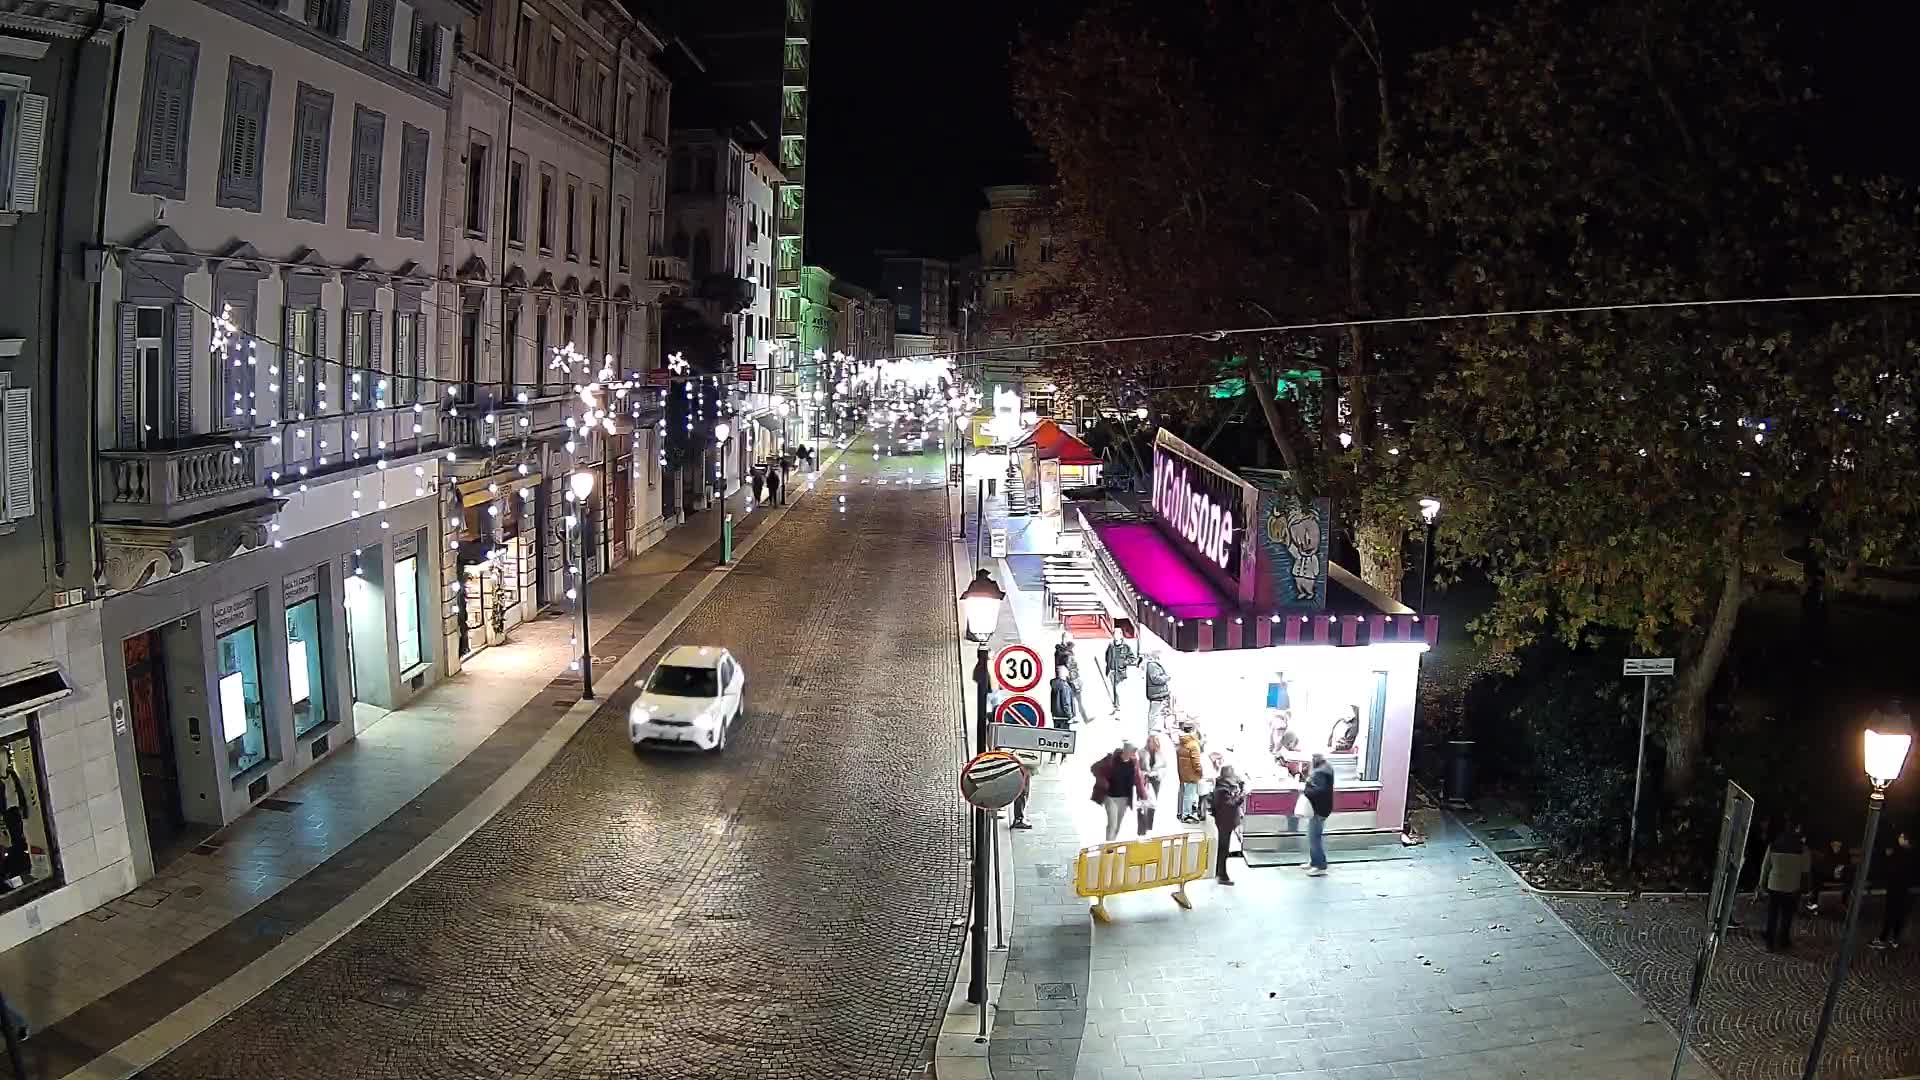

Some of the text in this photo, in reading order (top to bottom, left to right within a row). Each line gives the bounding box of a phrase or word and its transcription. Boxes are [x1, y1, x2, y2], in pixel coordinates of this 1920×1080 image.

[1163, 459, 1232, 568] Golosone
[1005, 657, 1033, 680] 30
[1038, 737, 1070, 749] Dante
